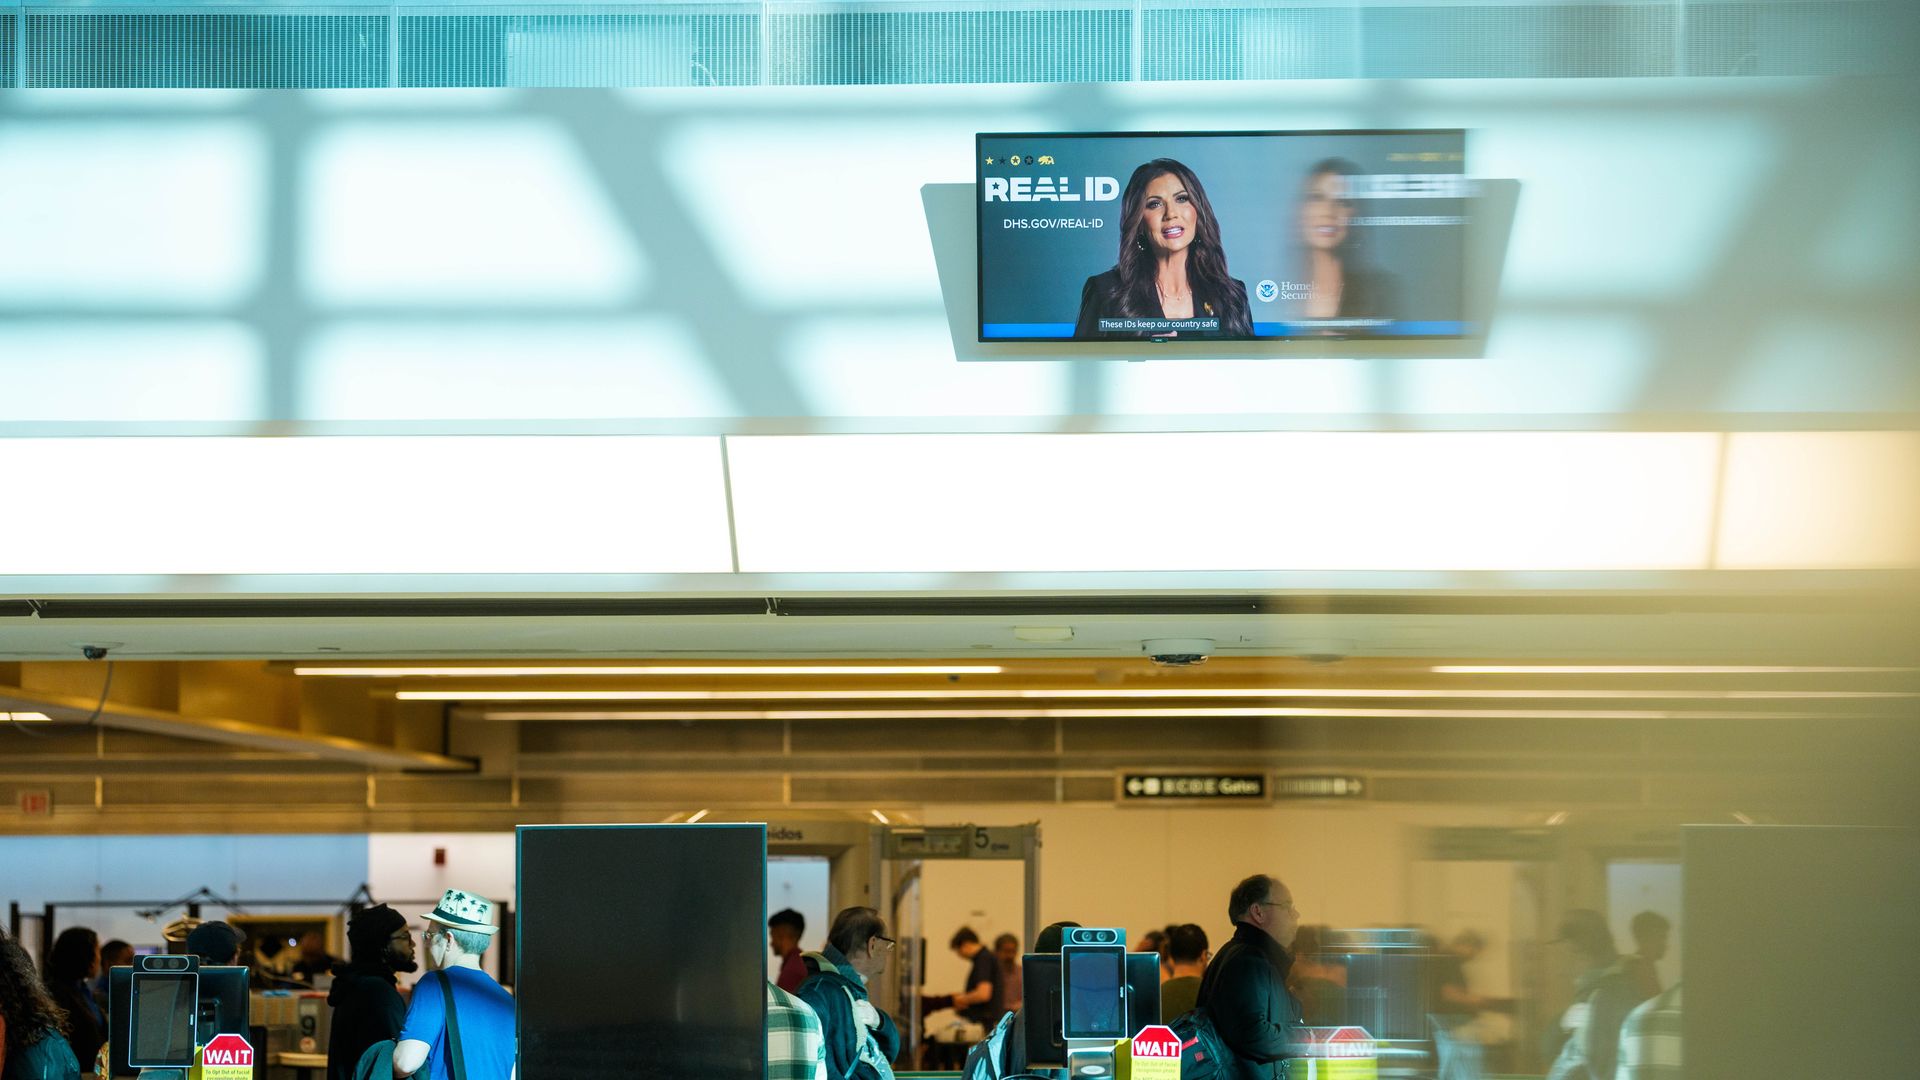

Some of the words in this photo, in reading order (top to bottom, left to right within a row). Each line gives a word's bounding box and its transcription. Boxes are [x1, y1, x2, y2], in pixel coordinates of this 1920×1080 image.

[984, 177, 1080, 202] REAL
[1085, 177, 1120, 202] ID
[1003, 218, 1104, 229] DHS.GOV/REAL-ID
[1281, 281, 1317, 291] Homel
[1281, 291, 1317, 300] Securi
[1100, 320, 1123, 328] These
[1124, 320, 1136, 328] IDs
[1137, 320, 1156, 329] keep
[1171, 320, 1200, 329] country
[1201, 319, 1218, 328] safe
[1218, 777, 1260, 795] Gates
[975, 827, 990, 849] 5
[206, 1049, 250, 1064] WAIT
[1134, 1041, 1179, 1057] WAIT
